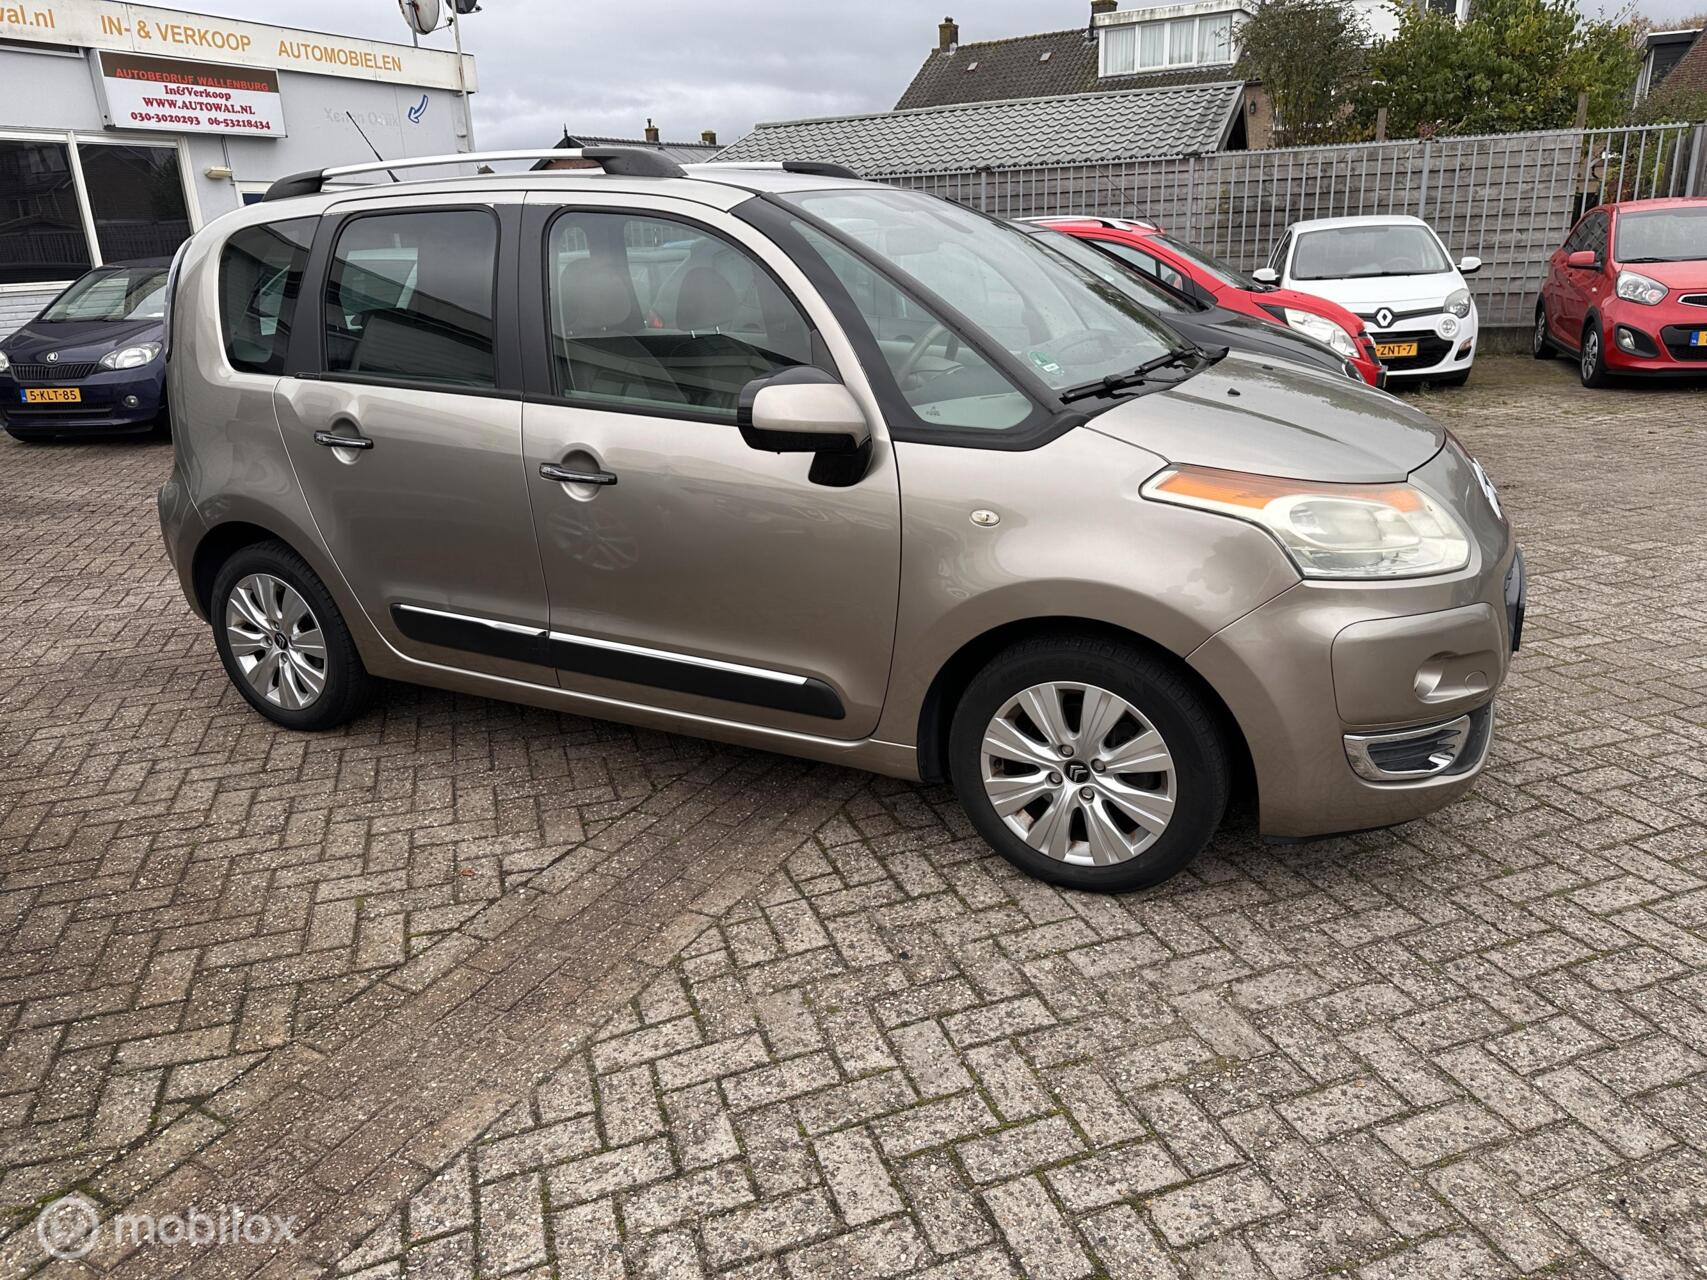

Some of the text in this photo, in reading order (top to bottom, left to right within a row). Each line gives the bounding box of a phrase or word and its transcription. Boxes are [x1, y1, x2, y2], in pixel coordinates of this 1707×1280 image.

[101, 15, 251, 52] IN- & VERKOOP
[278, 40, 402, 72] AUTOMOBIELEN
[115, 67, 269, 91] AUTOBEDRIJF WALLENBURG
[164, 85, 232, 101] In&Verkoop
[143, 97, 256, 115] WWW.AUTOWAL.NL
[130, 111, 271, 130] 030-3020293 06-53218434
[1376, 344, 1413, 356] -ZNT-7
[30, 390, 77, 400] 5-KLT-85
